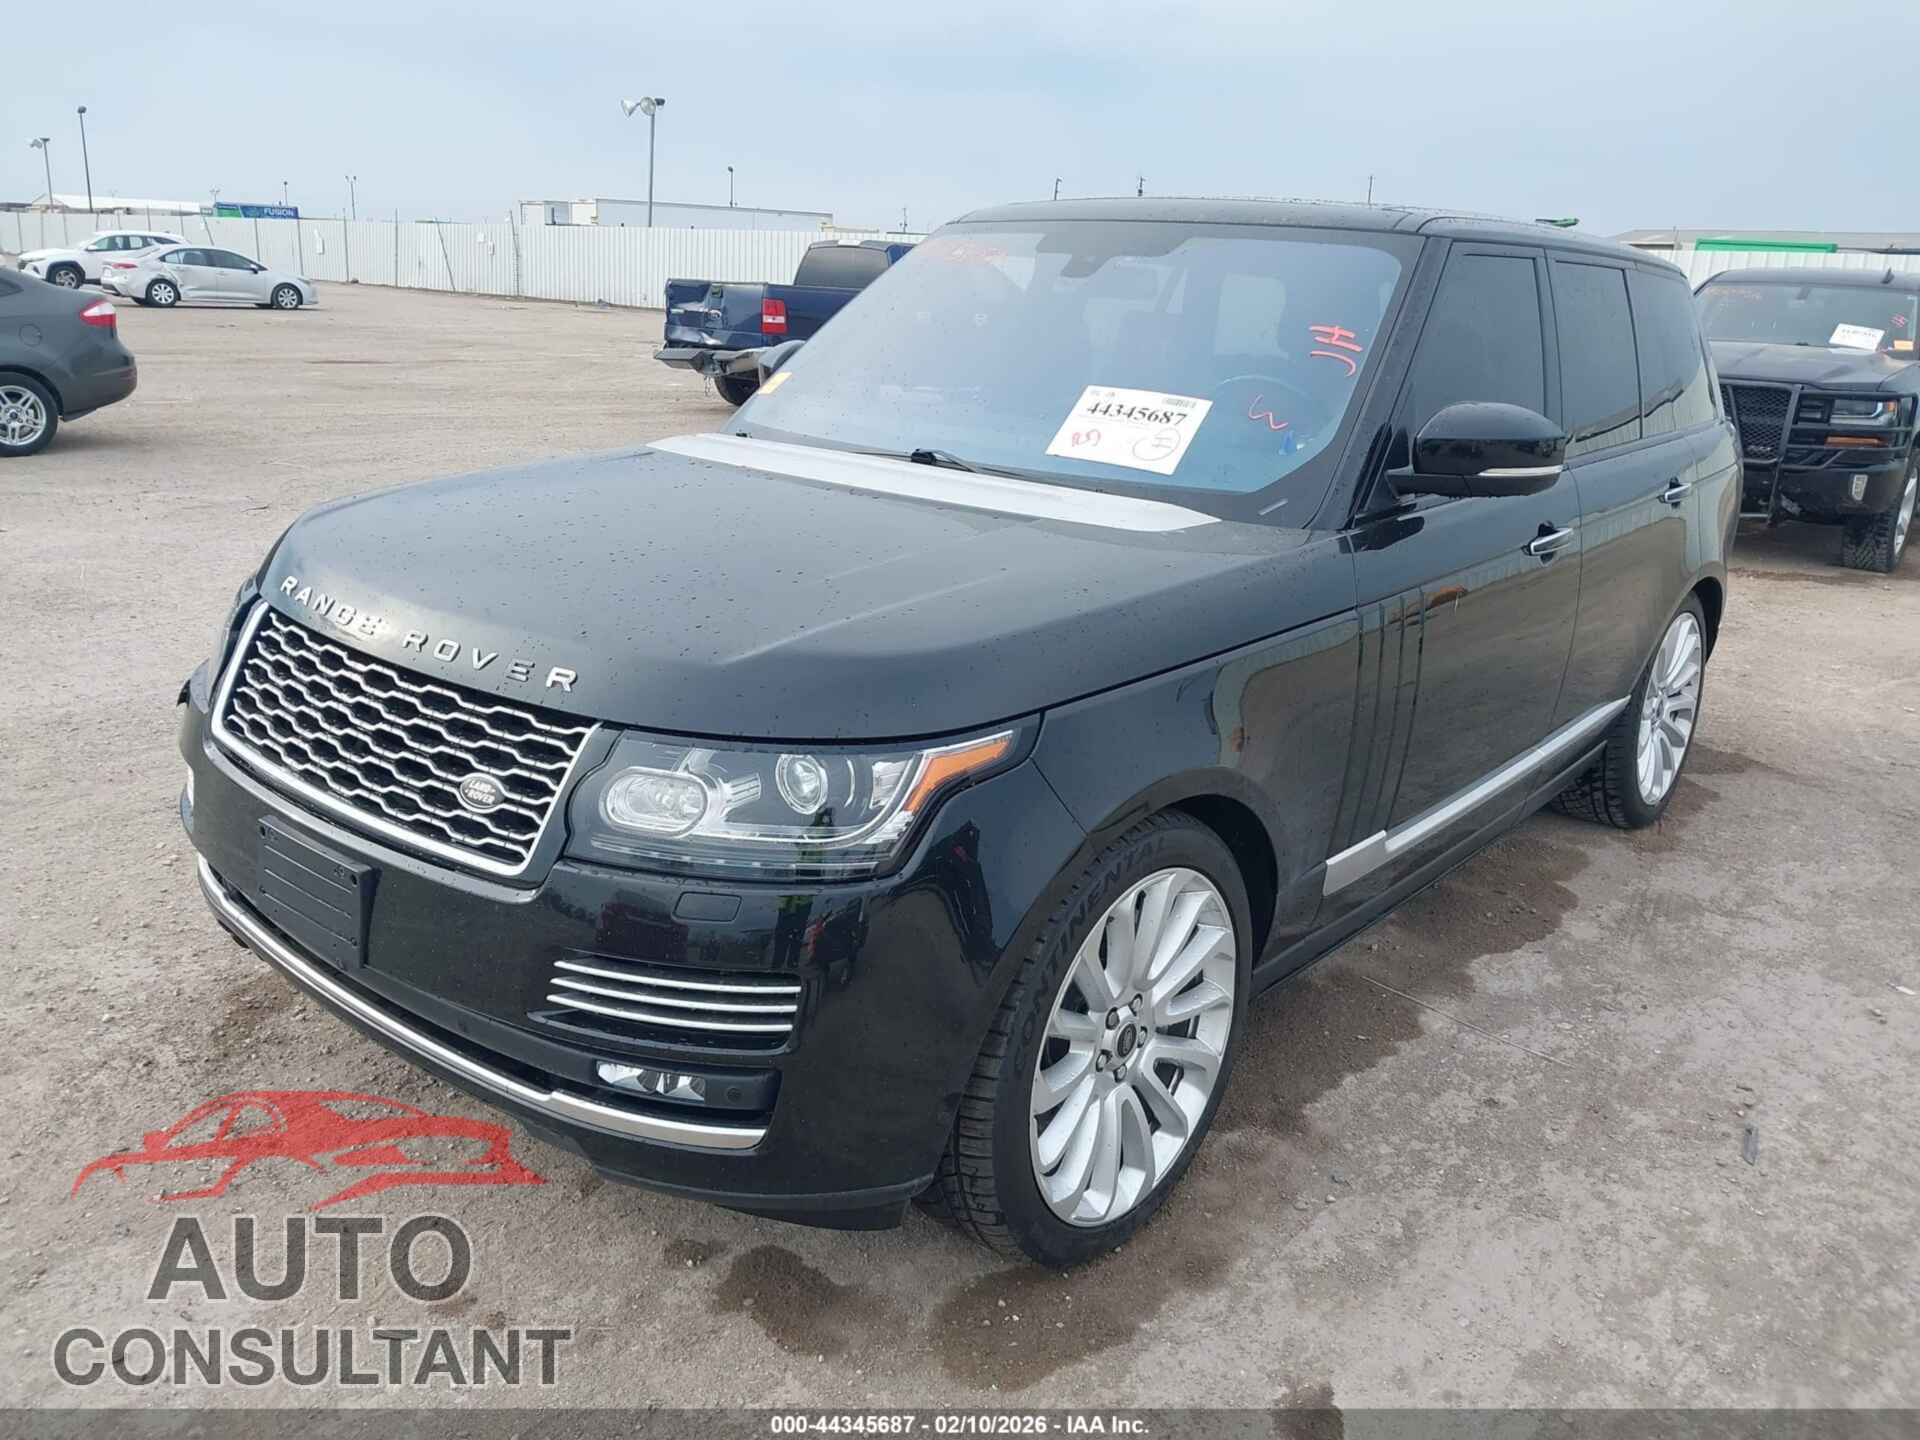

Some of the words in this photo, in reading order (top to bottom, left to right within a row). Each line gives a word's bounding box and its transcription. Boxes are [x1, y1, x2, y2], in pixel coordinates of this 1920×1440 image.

[1087, 401, 1188, 427] 44345687
[280, 574, 383, 637] RANGE
[402, 629, 578, 693] ROVER
